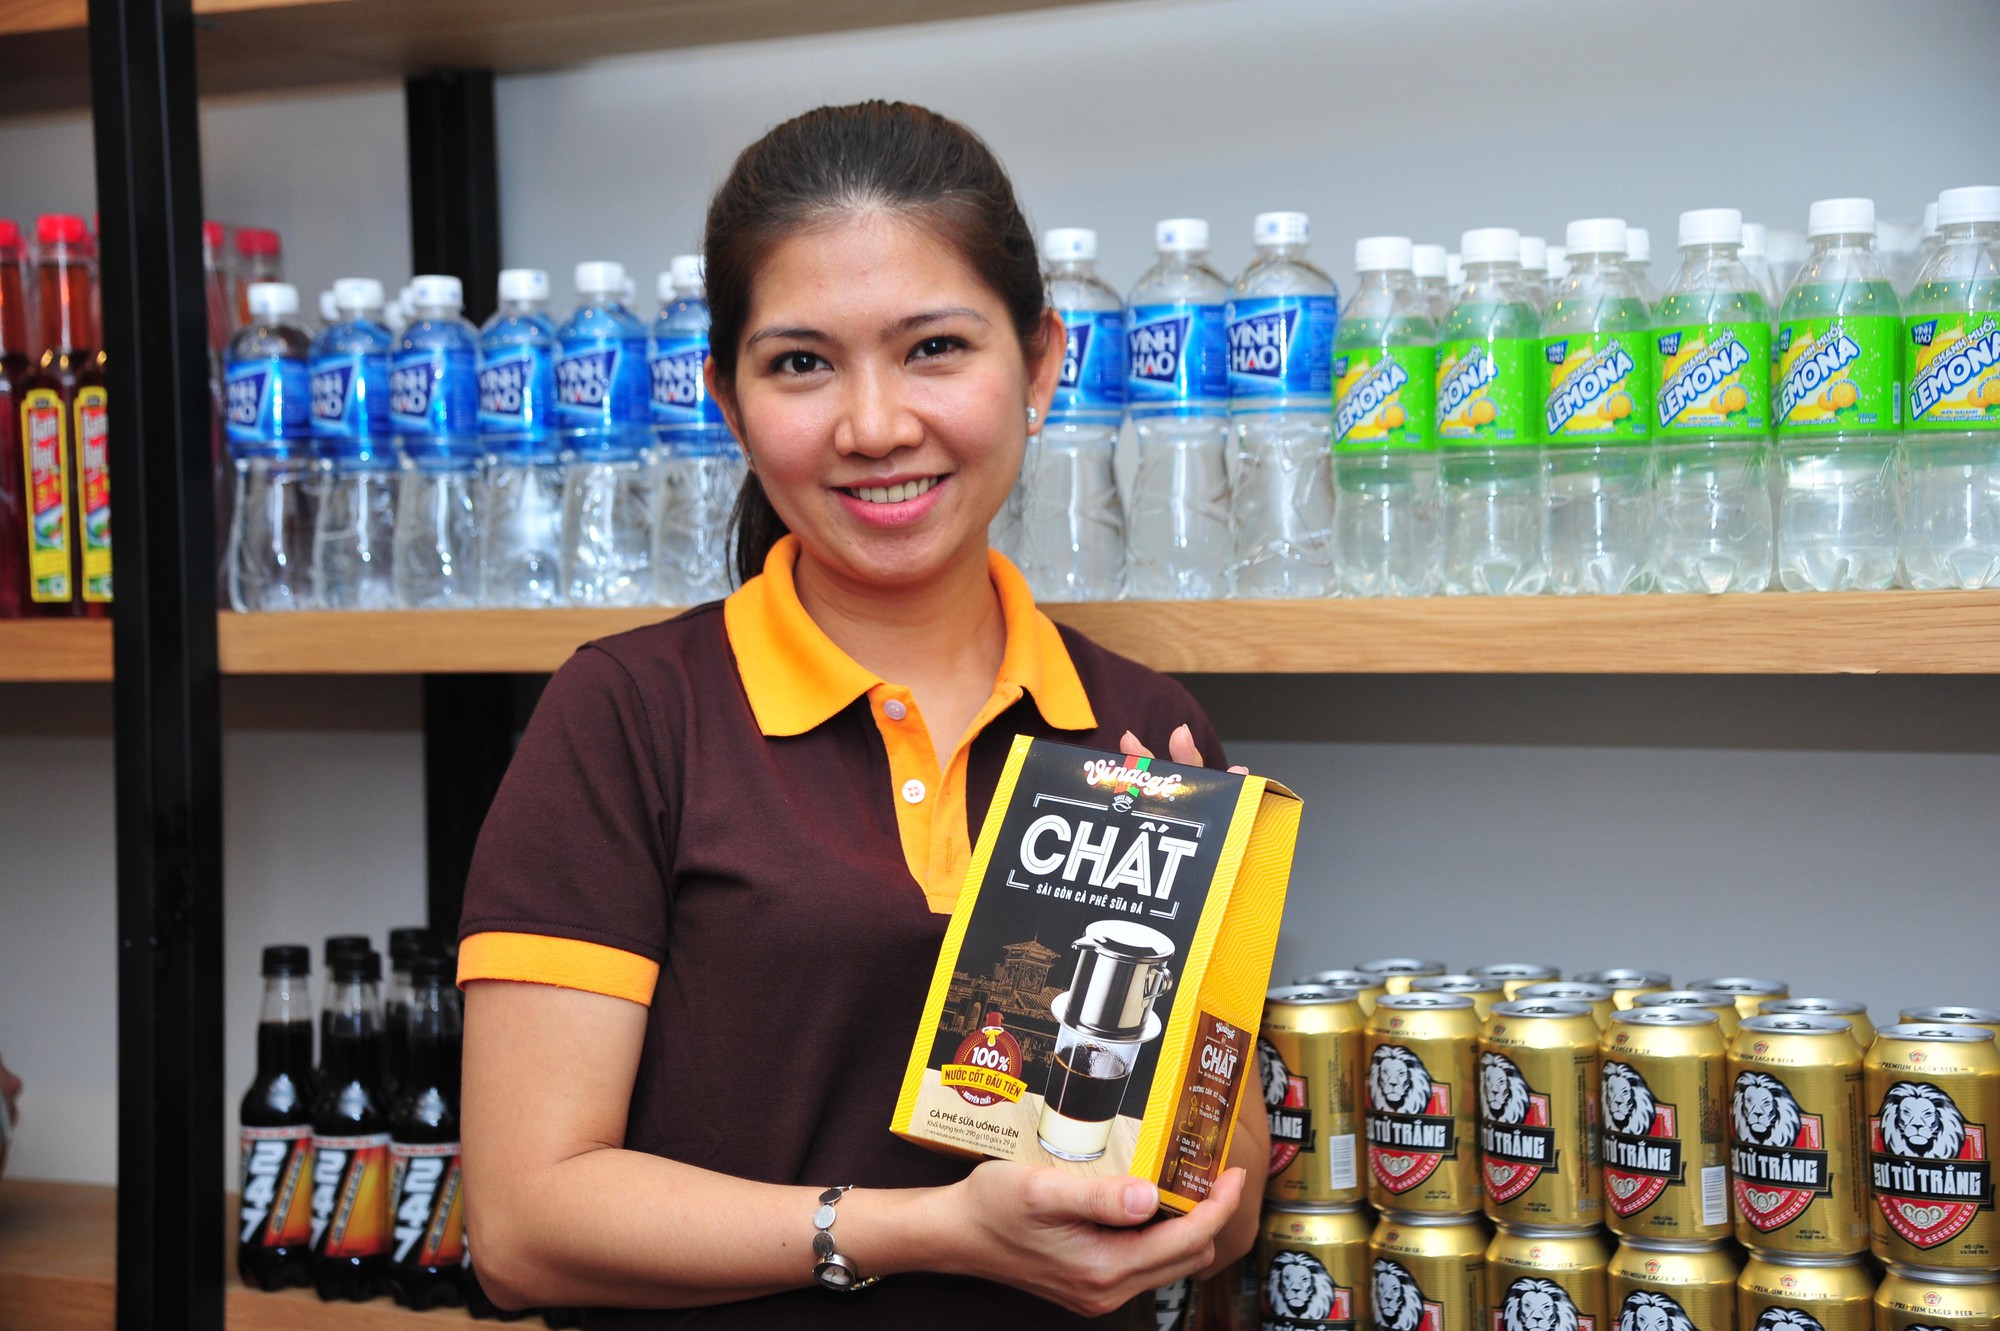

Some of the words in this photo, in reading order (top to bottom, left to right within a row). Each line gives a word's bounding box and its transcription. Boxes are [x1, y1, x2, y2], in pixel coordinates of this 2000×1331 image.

[1547, 350, 1635, 435] LEMONA
[1659, 341, 1749, 427] LEMONA
[1335, 363, 1408, 444] LEMONA
[1020, 815, 1198, 900] CHẤT
[1036, 882, 1052, 896] SÀI
[1053, 886, 1073, 900] GÒN
[1074, 890, 1087, 903] CÀ
[1089, 894, 1108, 907] PHÊ
[1109, 897, 1127, 911] SỮA
[1130, 901, 1144, 914] ĐÁ
[971, 1046, 1009, 1072] 100%
[1201, 1044, 1237, 1079] CHẤT
[945, 1067, 967, 1081] NƯỚC
[969, 1069, 985, 1083] CỐT
[1003, 1081, 1022, 1097] TIÊN
[930, 1109, 940, 1119] CÀ
[941, 1112, 958, 1123] PHÊ
[958, 1116, 974, 1127] SỮA
[976, 1120, 1000, 1133] UỐNG
[1001, 1125, 1020, 1138] LIỀN
[1392, 1119, 1446, 1147] TRẮNG
[1494, 1129, 1546, 1159] TRẮNG
[1618, 1140, 1671, 1171] TRẮNG
[1740, 1148, 1757, 1177] TỬ
[1758, 1152, 1818, 1184] TRẮNG
[1873, 1162, 1890, 1188] SƯ
[1891, 1161, 1915, 1191] TỬ
[1917, 1165, 1981, 1196] TRẮNG
[1928, 1308, 1952, 1316] LAGER
